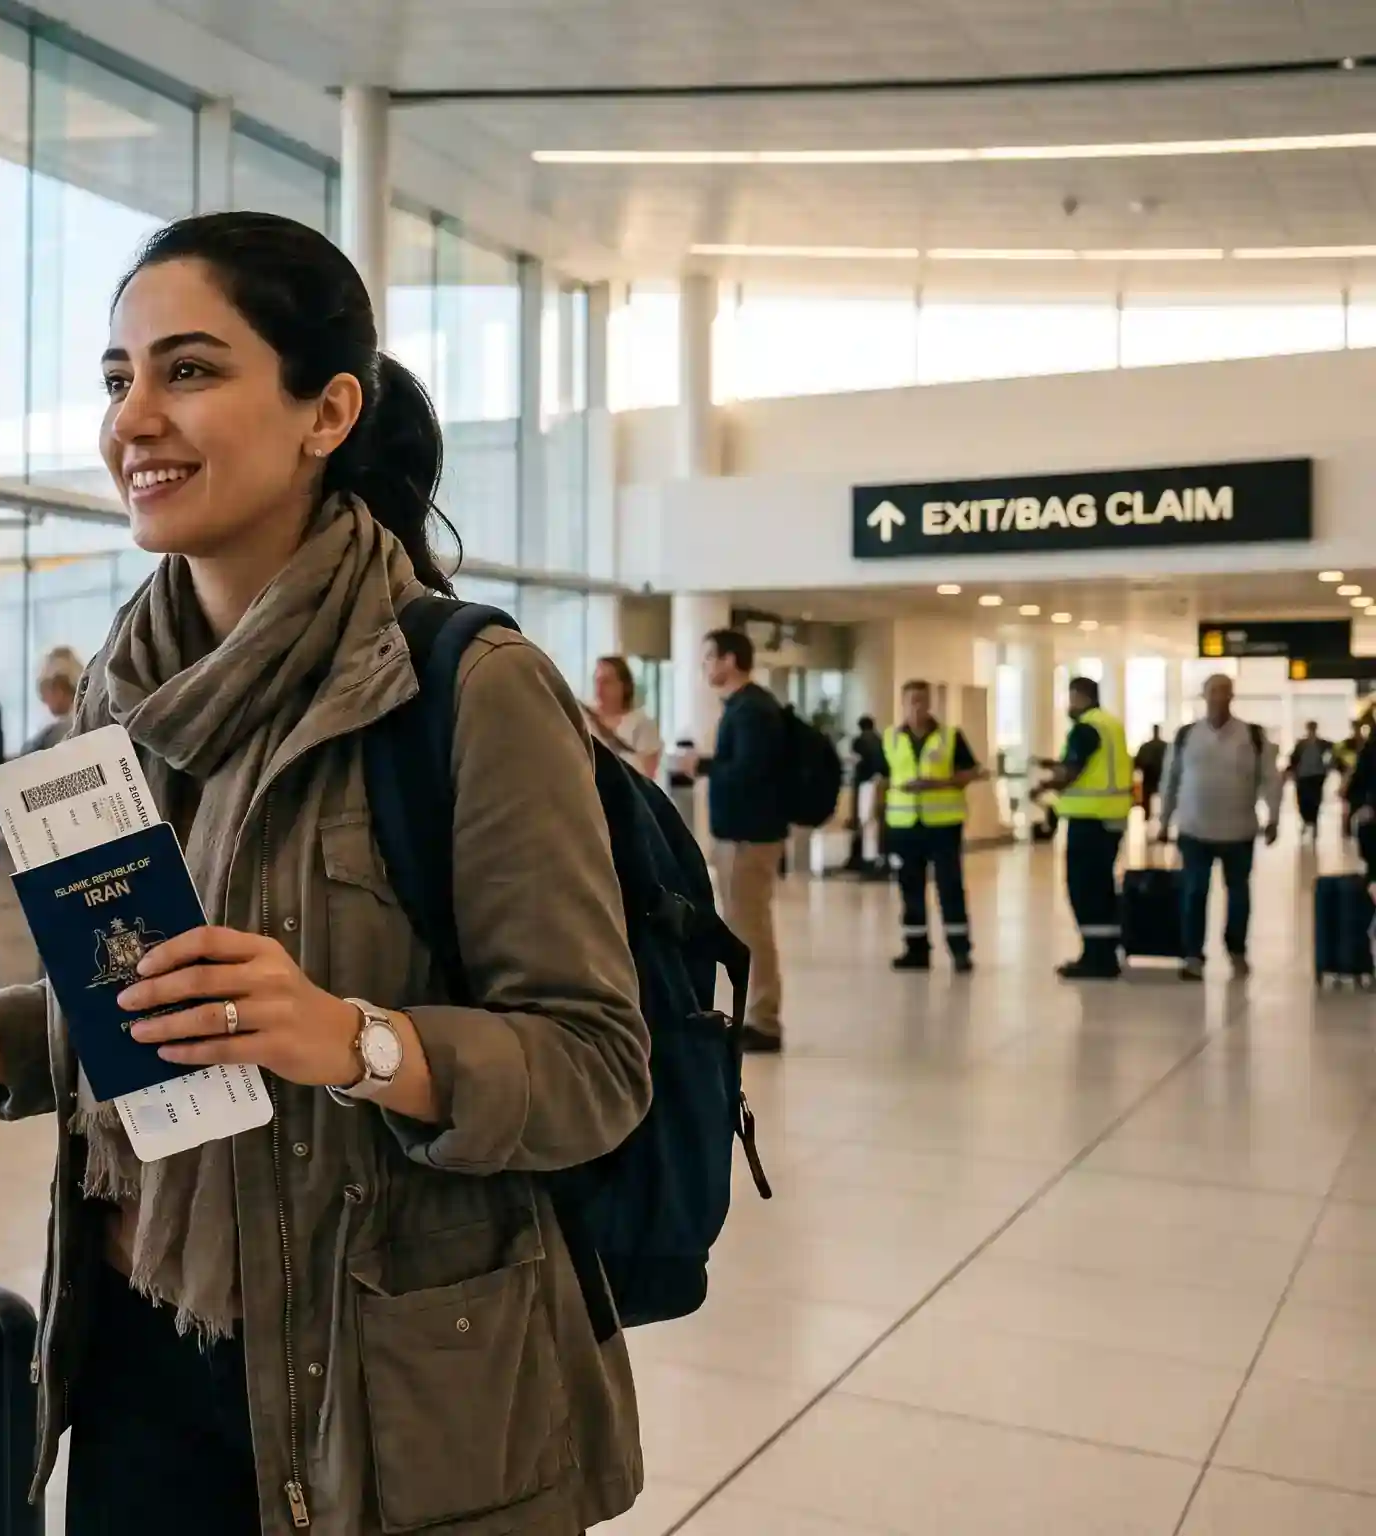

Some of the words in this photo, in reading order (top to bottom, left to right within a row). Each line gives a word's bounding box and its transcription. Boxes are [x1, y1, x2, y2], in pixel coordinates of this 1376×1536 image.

[922, 493, 1097, 535] EXIT/BAG
[1105, 485, 1233, 526] CLAIM
[54, 878, 92, 898] ISLAMIC
[91, 862, 137, 885] REPUBLIC
[137, 856, 151, 869] OF
[84, 879, 132, 907] IRAN
